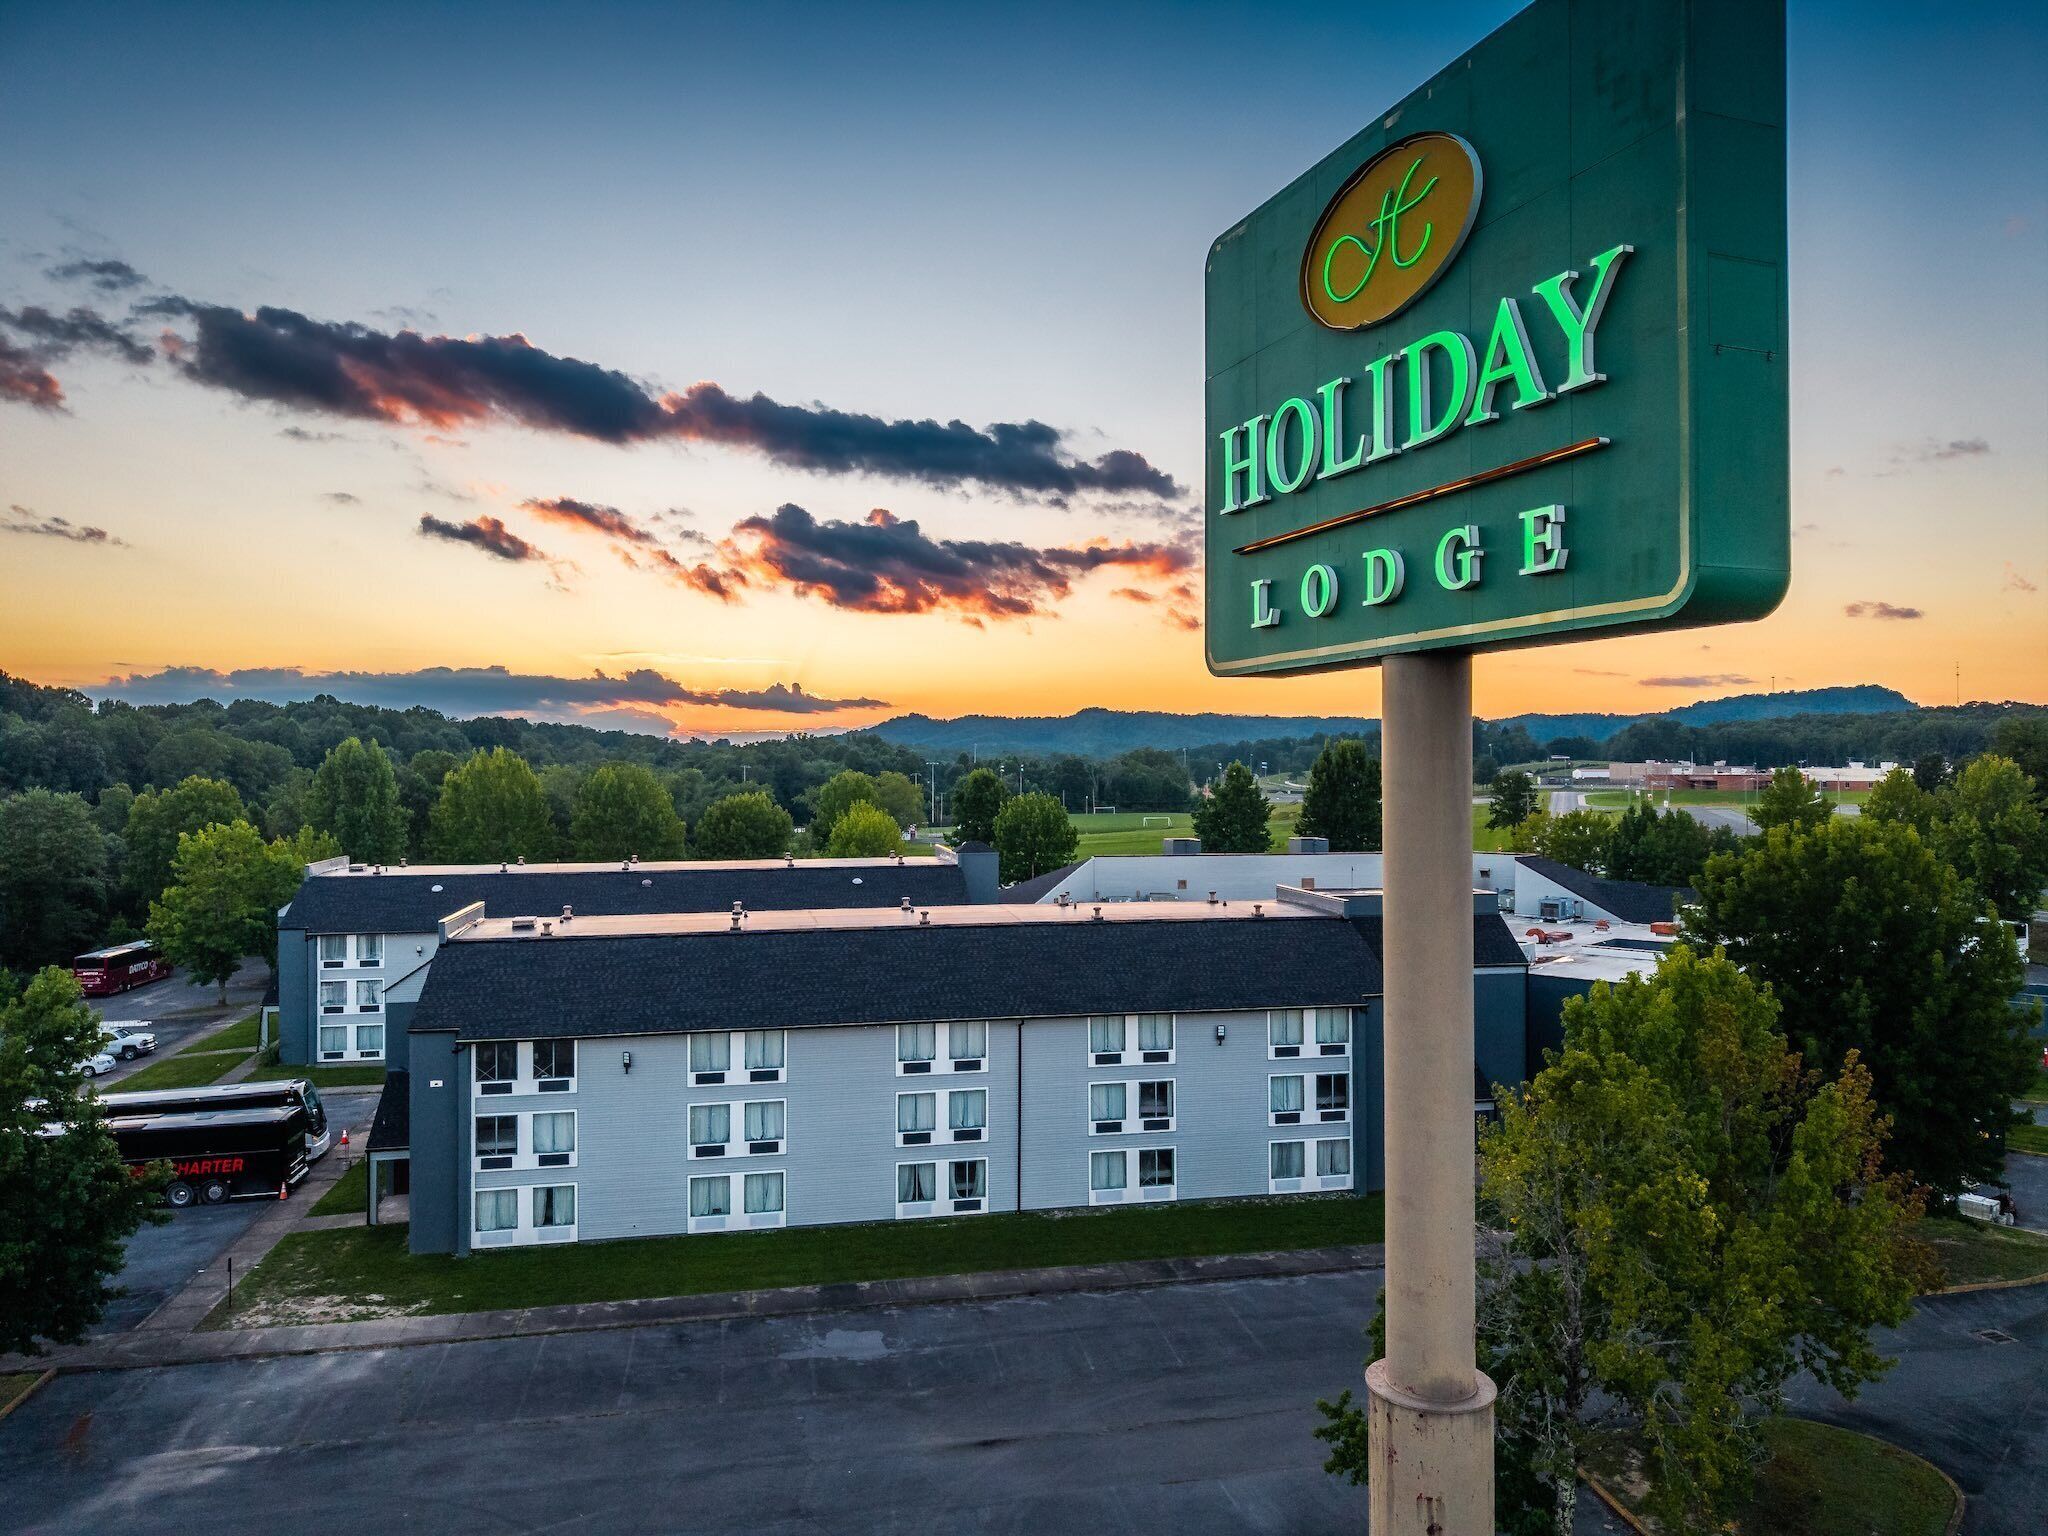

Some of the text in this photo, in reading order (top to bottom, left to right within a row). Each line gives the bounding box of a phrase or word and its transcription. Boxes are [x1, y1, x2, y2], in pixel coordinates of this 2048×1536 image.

[1220, 244, 1634, 516] HOLIDAY
[1251, 503, 1569, 629] LODGE
[173, 1159, 243, 1175] HARTER
